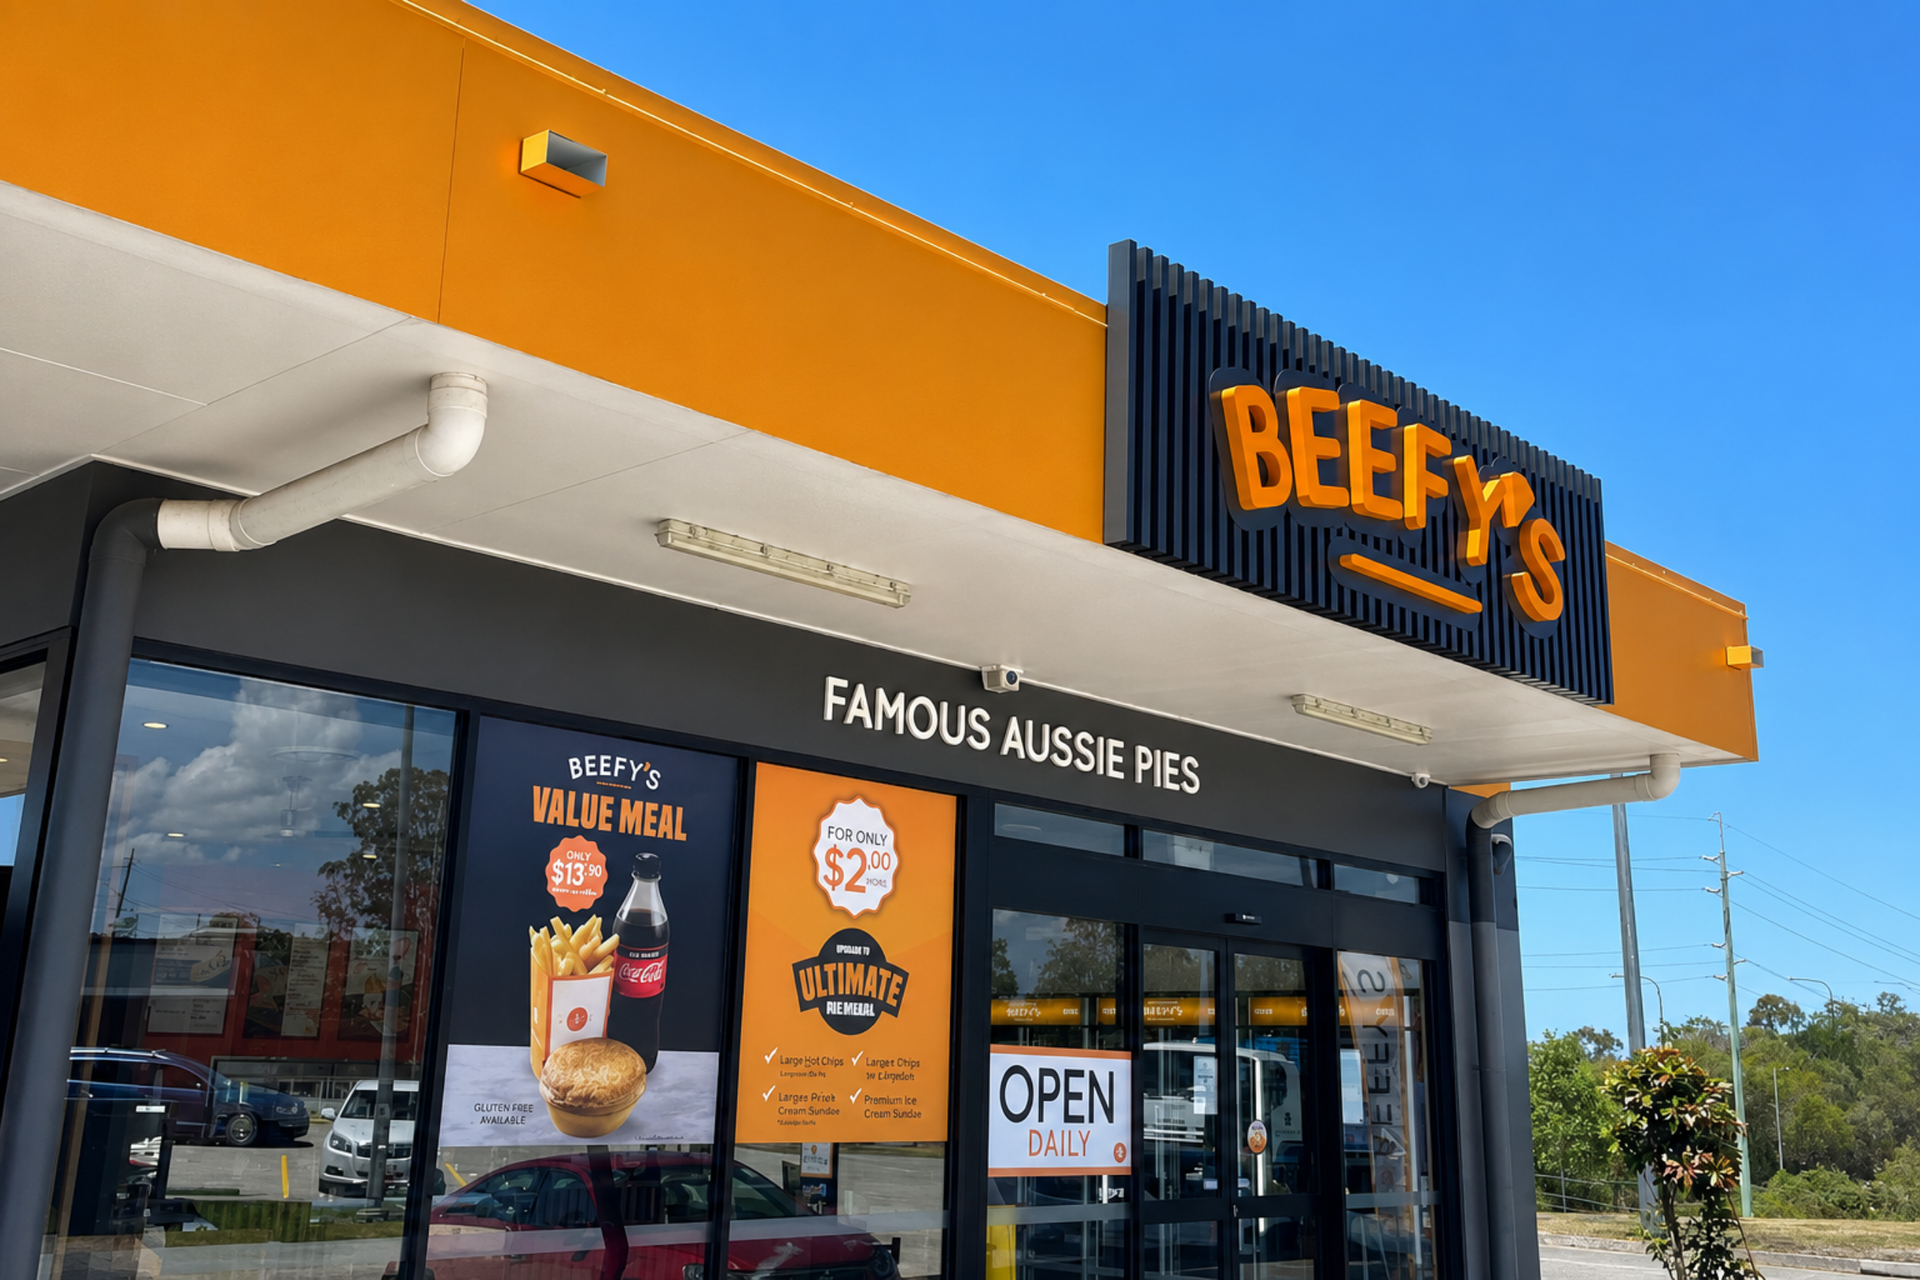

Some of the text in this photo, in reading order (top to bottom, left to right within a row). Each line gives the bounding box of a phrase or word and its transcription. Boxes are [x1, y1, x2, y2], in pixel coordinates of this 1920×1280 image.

[1221, 384, 1566, 622] BEEFY'S
[823, 676, 1201, 795] FAMOUS AUSSIE PIES
[568, 754, 661, 790] BEEFY'S
[532, 785, 687, 842] VALUE MEAL
[827, 825, 888, 847] FOR ONLY
[798, 962, 904, 1008] ULTIMATE
[821, 1055, 845, 1069] Chips
[474, 1102, 511, 1113] GLUTEN
[864, 1094, 903, 1106] Premium
[999, 1064, 1115, 1125] OPEN
[1028, 1128, 1091, 1157] DAILY
